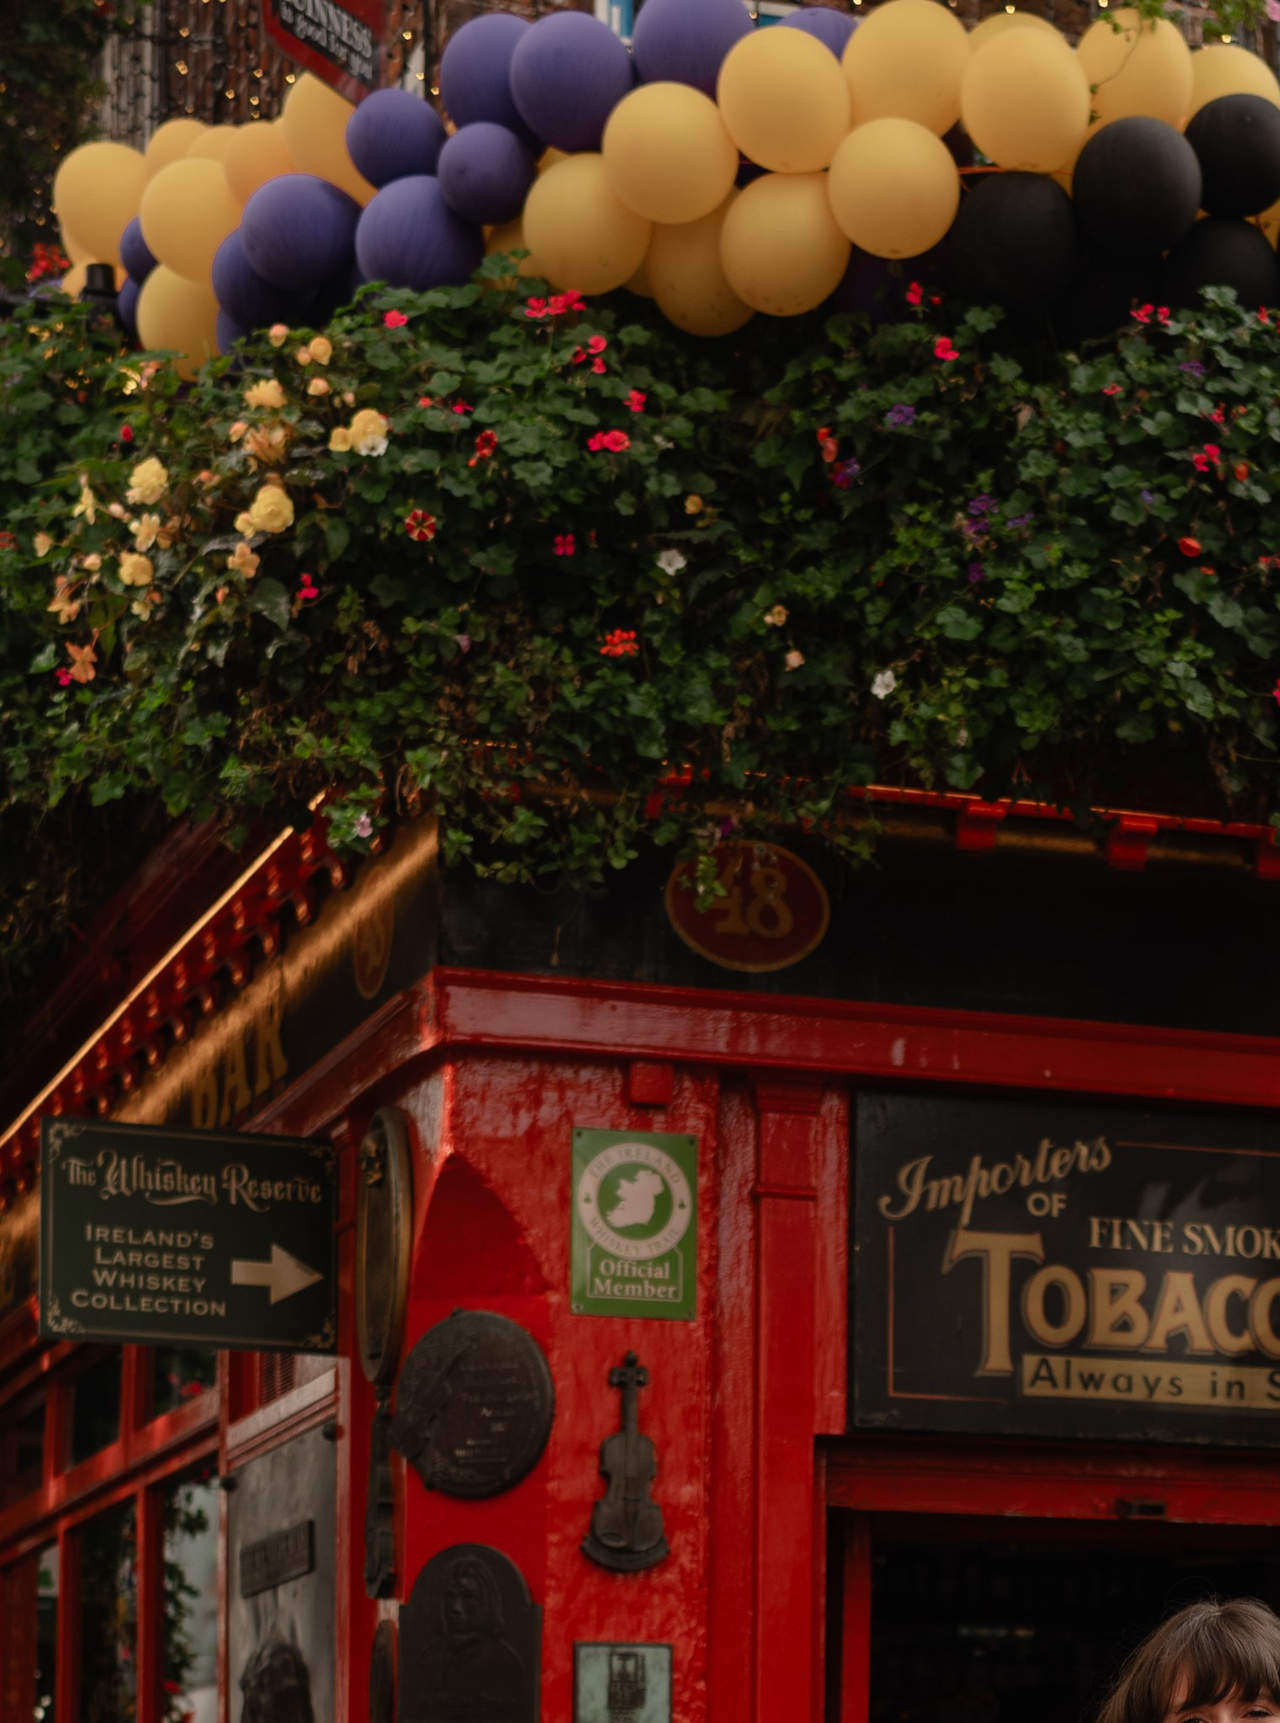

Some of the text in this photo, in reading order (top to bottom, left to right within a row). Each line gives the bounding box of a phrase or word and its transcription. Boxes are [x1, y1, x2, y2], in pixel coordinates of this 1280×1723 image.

[62, 1149, 322, 1213] The Whiskey Reserve
[878, 1135, 1114, 1228] Importers
[1026, 1192, 1067, 1218] OF
[85, 1223, 215, 1250] IRELAND'S
[1089, 1216, 1174, 1254] FINE
[95, 1247, 205, 1271] LARGEST
[600, 1259, 670, 1281] Official
[92, 1269, 207, 1294] WHISKEY
[593, 1278, 677, 1299] Member
[70, 1289, 227, 1317] COLLECTION
[1029, 1356, 1185, 1399] Always
[1209, 1371, 1246, 1400] in
